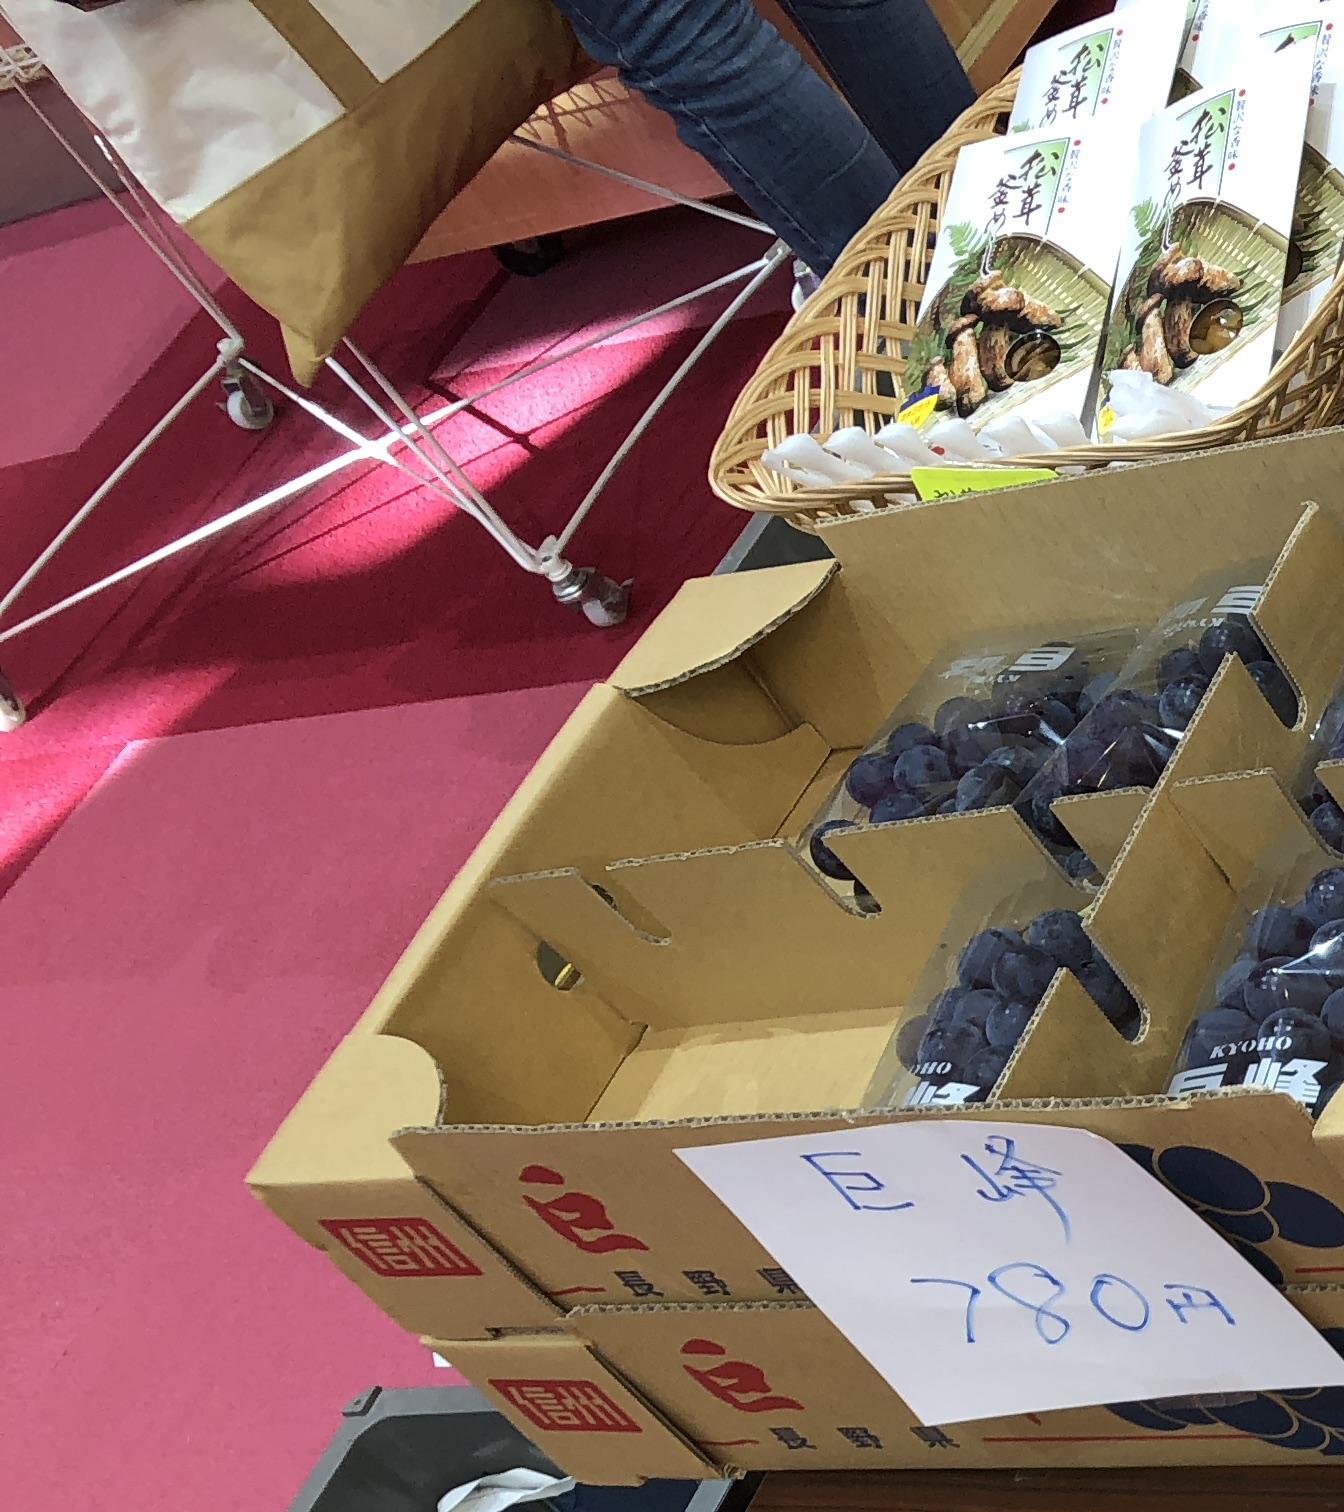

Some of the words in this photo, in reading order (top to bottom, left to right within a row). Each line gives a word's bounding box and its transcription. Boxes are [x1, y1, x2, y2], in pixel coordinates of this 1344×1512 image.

[1061, 43, 1105, 119] 松茸
[1012, 149, 1060, 227] 松茸
[1186, 108, 1227, 190] 松茸
[1209, 1035, 1293, 1060] KYOHO
[800, 1135, 1072, 1245] 巨峰
[910, 1261, 1237, 1346] 780円
